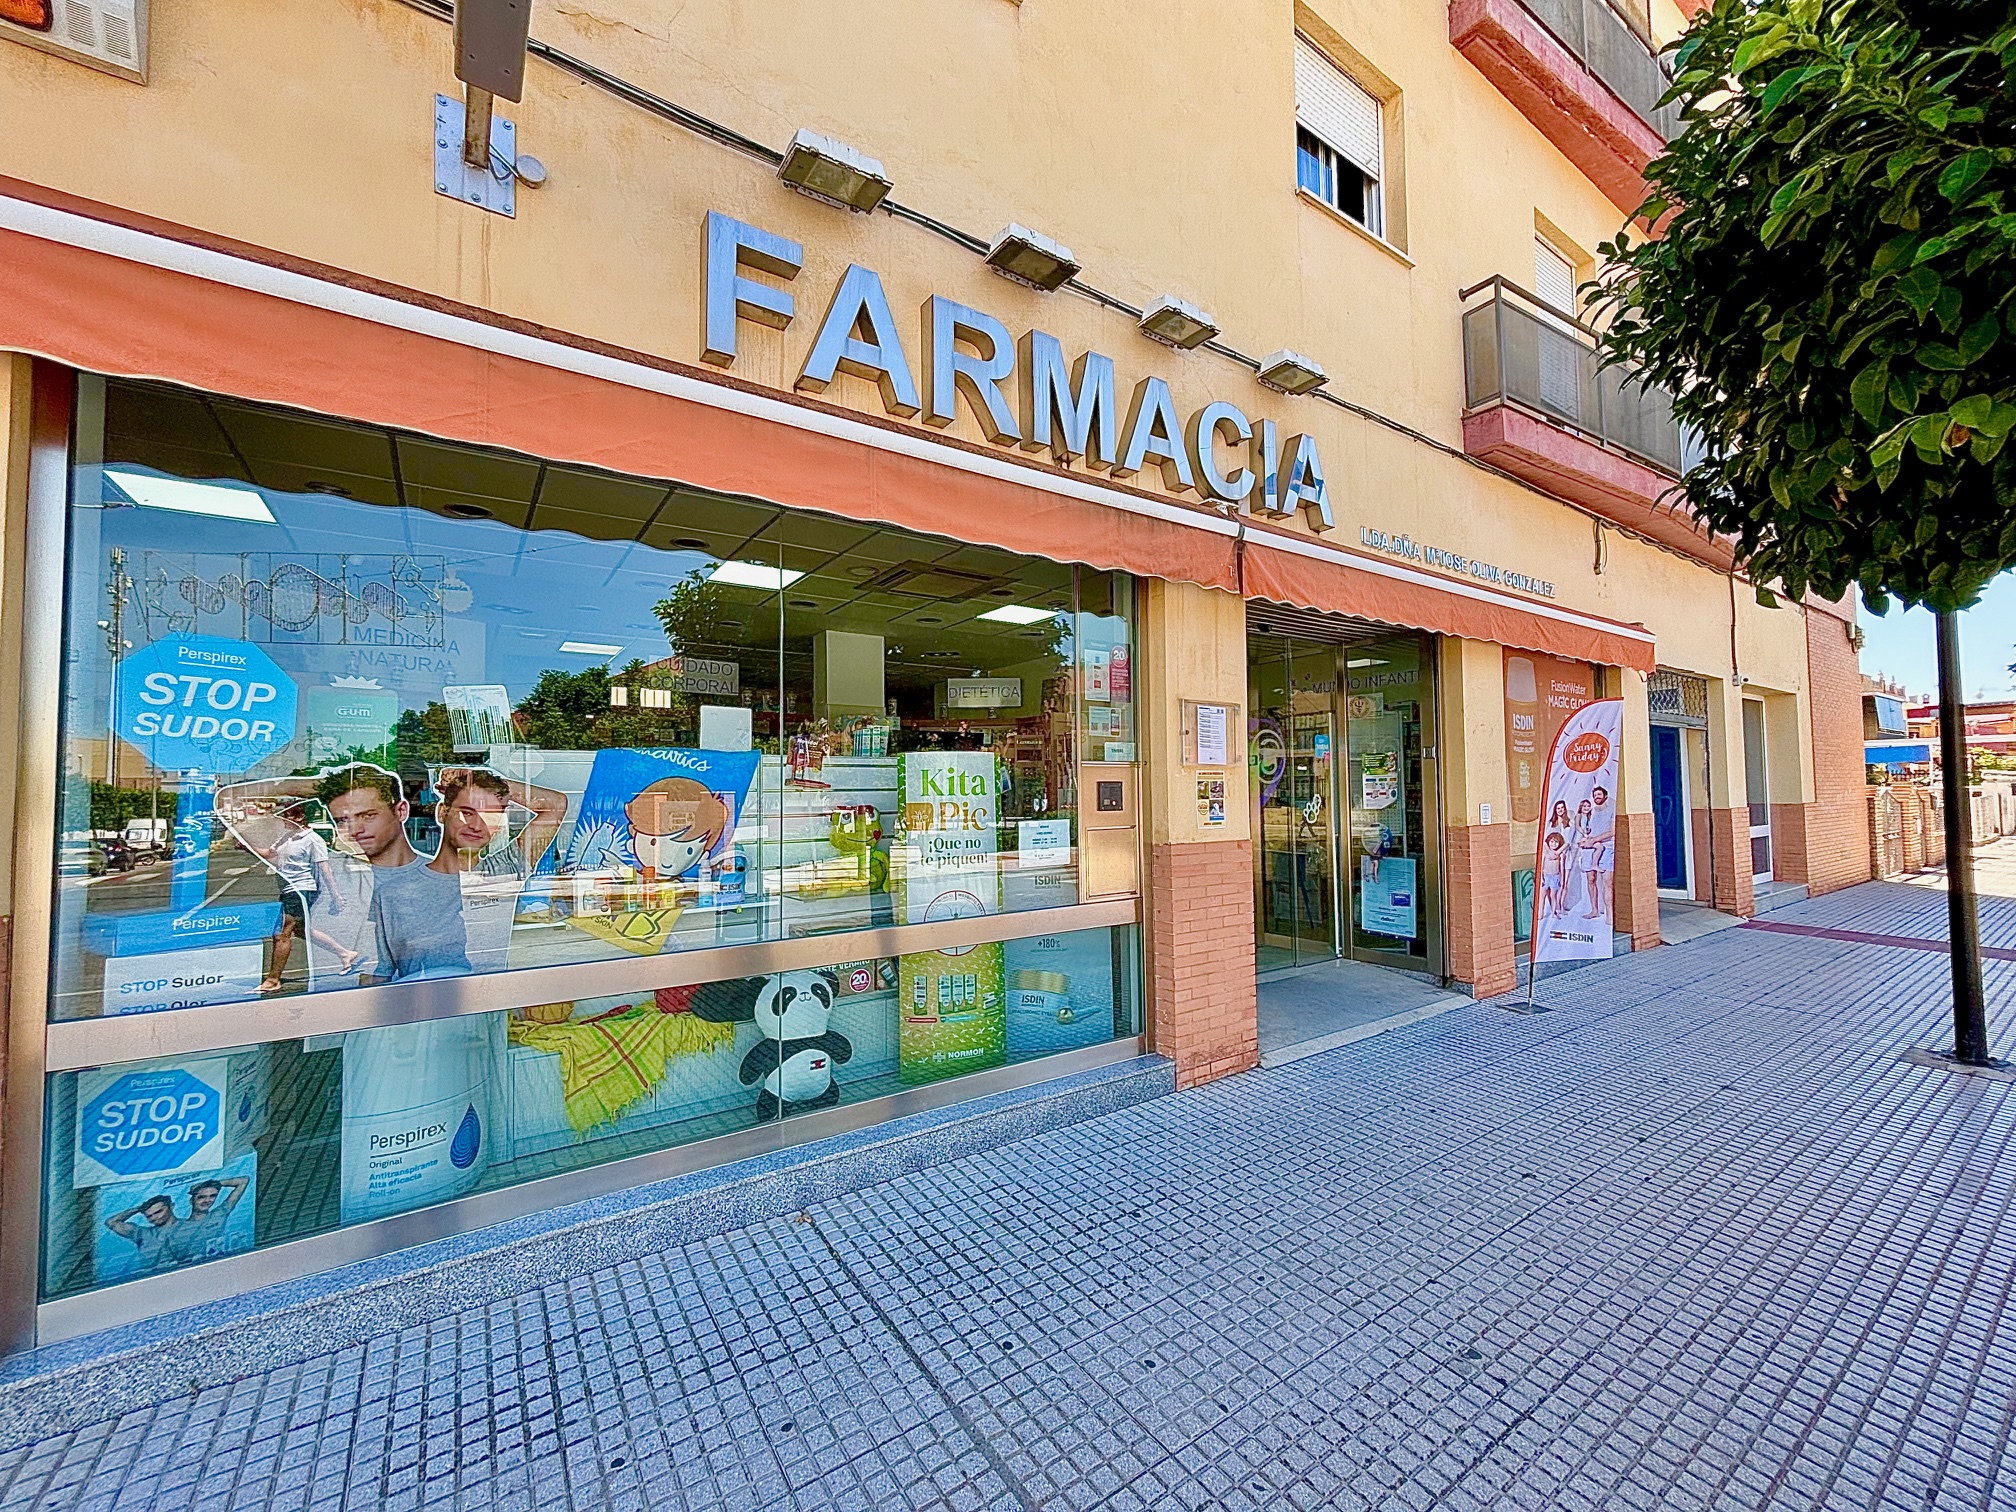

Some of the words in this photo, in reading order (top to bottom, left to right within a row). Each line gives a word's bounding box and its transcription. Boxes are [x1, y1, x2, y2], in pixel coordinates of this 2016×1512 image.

[700, 209, 1335, 533] FARMACIA
[1471, 560, 1502, 584] OLIVA
[1503, 570, 1556, 598] GONZALEZ
[354, 626, 461, 655] MEDICINA
[178, 646, 247, 665] Perspirex
[656, 657, 733, 676] CUIDADO
[139, 672, 277, 712] STOP
[649, 675, 739, 694] CORPORAL
[948, 685, 1020, 699] DIETÉTICA
[1548, 695, 1569, 709] MAGIC
[133, 712, 275, 742] SUDOR
[1513, 713, 1534, 730] ISDIN
[1569, 751, 1599, 763] Friday
[1573, 743, 1602, 754] Sunny
[920, 767, 987, 797] Kita
[939, 801, 988, 832] Pic
[929, 837, 961, 853] ¡Que
[965, 839, 982, 849] no
[937, 851, 988, 869] piquen!
[1034, 875, 1061, 885] ISDIN
[173, 915, 240, 931] Perspirex
[594, 916, 613, 929] SKIN
[1569, 933, 1593, 943] ISDIN
[120, 979, 168, 994] STOP
[172, 975, 224, 988] Sudor
[1021, 994, 1045, 1004] ISDIN
[947, 1048, 985, 1058] NORMON
[130, 1076, 176, 1088] Perspirex
[97, 1092, 206, 1128] STOP
[94, 1121, 206, 1152] SUDOR
[370, 1121, 448, 1150] Perspirex
[369, 1157, 402, 1169] Original
[369, 1159, 439, 1181] Antitranspirante
[369, 1180, 387, 1190] Alta
[388, 1173, 422, 1187] eficacia
[368, 1187, 401, 1199] Roll-on
